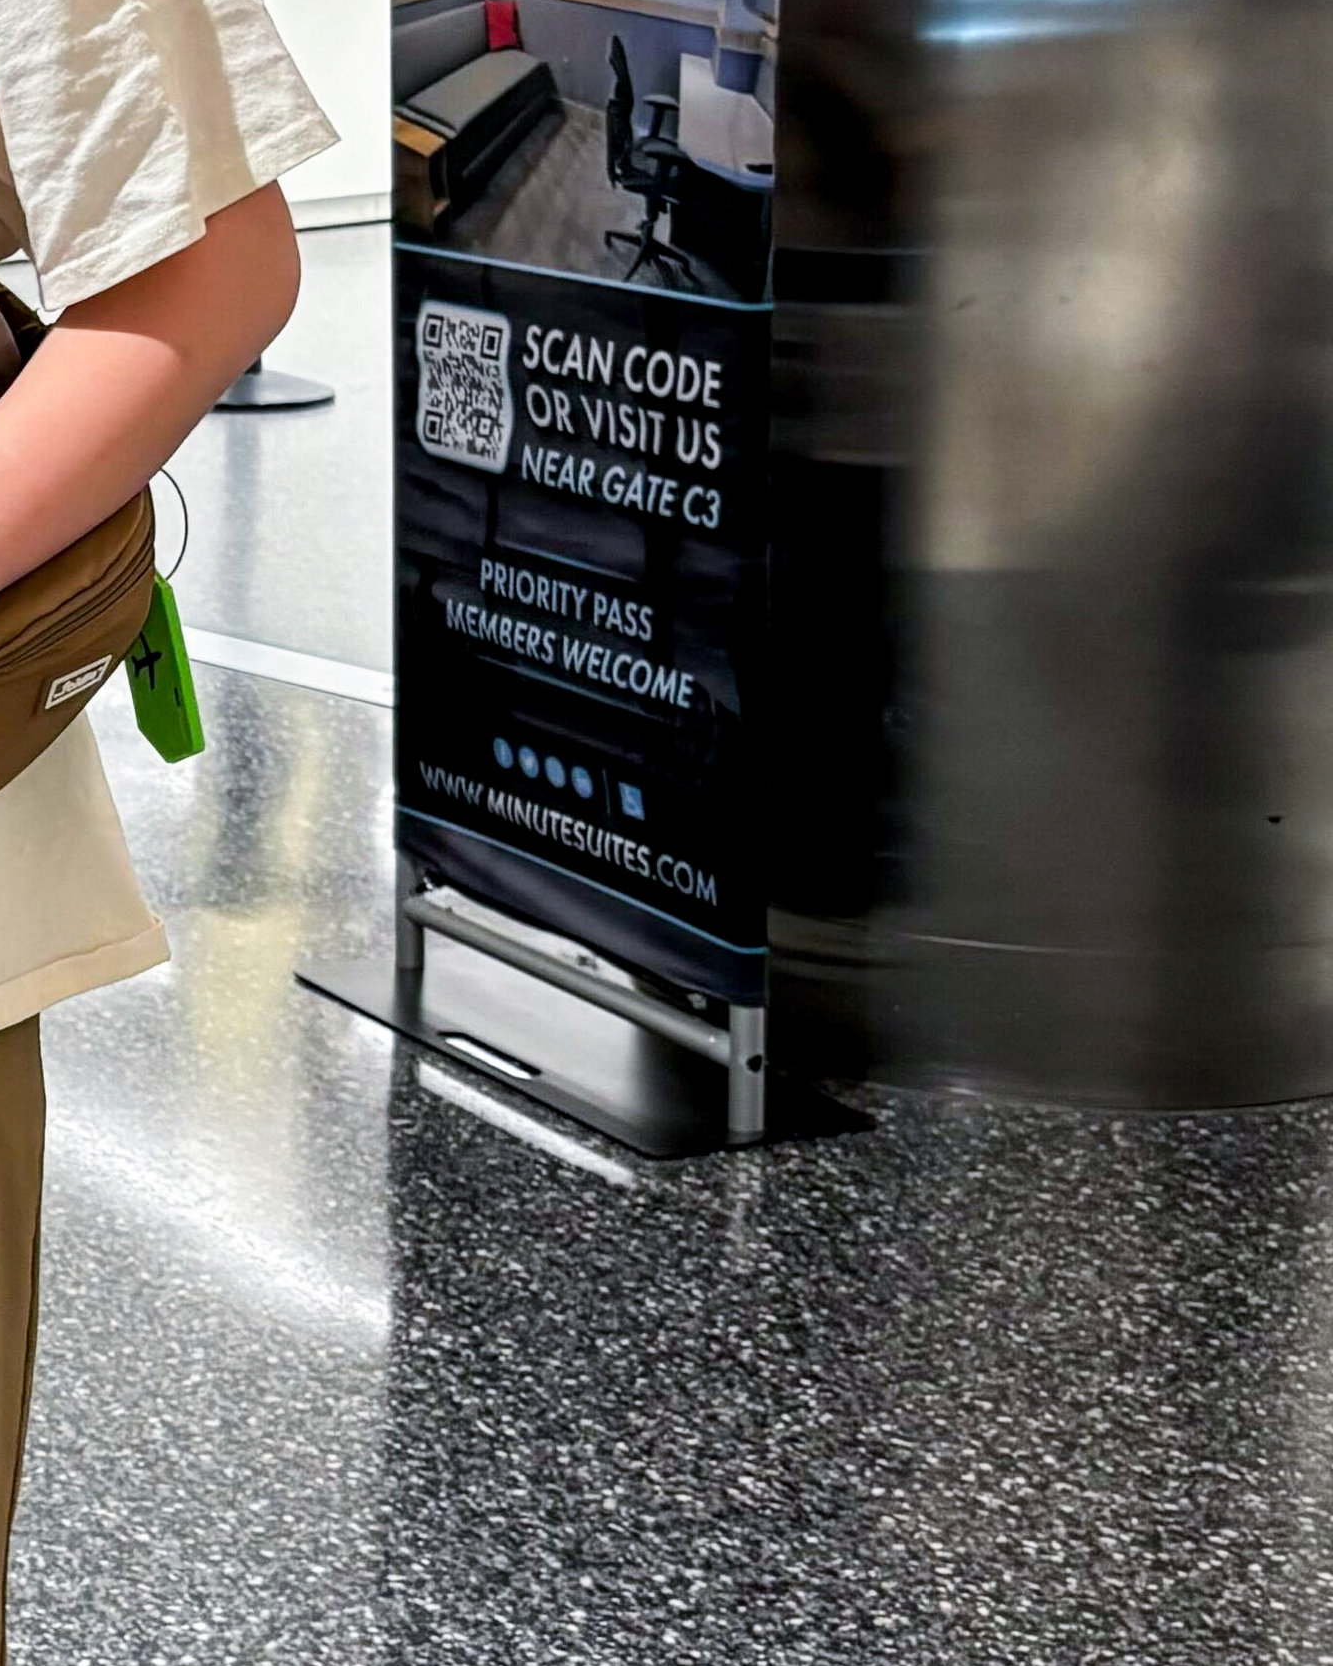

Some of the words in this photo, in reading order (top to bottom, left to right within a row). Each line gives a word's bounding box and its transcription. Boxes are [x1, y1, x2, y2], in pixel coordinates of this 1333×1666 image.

[522, 324, 614, 386] SCAN
[623, 345, 722, 409] CODE
[526, 384, 575, 434] OR
[580, 394, 666, 455] VISIT
[677, 415, 721, 470] US
[521, 444, 595, 498] NEAR
[602, 465, 678, 518] GATE
[683, 485, 721, 529] C3
[480, 557, 588, 622] PRIORITY
[592, 591, 654, 642] PASS
[445, 598, 556, 665] MEMBERS
[562, 635, 695, 709] WELCOME
[419, 760, 717, 907] WWWMINUTESUITES.COM
